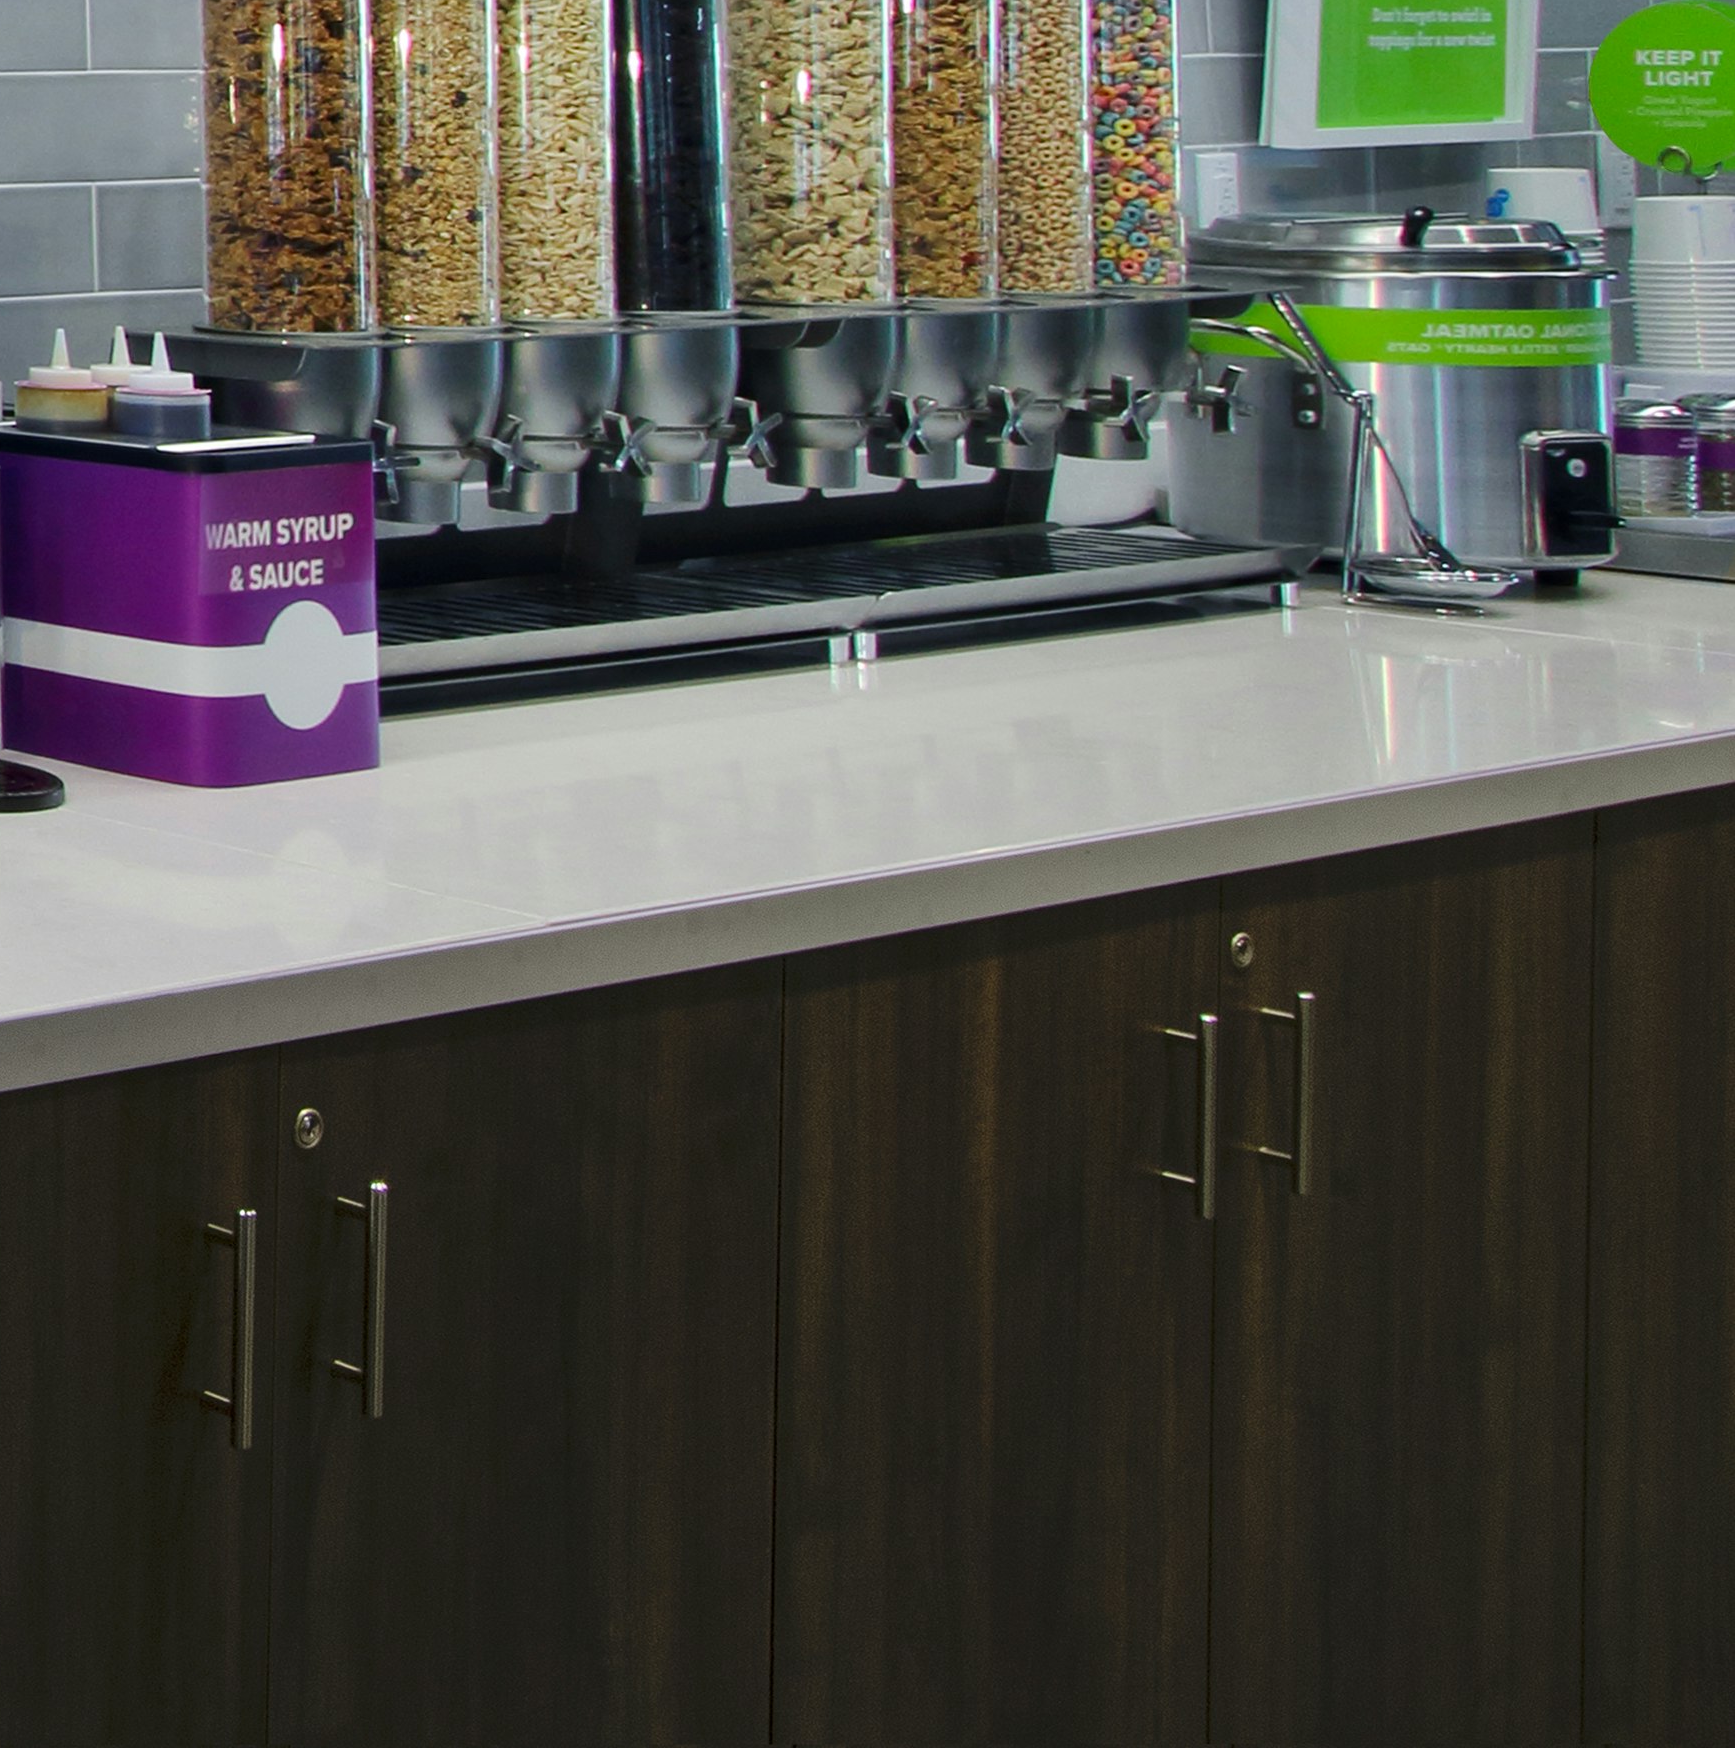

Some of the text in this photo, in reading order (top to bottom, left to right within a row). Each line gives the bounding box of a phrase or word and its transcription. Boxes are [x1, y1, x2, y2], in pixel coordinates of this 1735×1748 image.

[1635, 50, 1723, 65] KEEP IT
[1644, 70, 1714, 86] LIGHT
[205, 513, 354, 550] WARM SYRUP
[229, 560, 324, 592] & SAUCE
